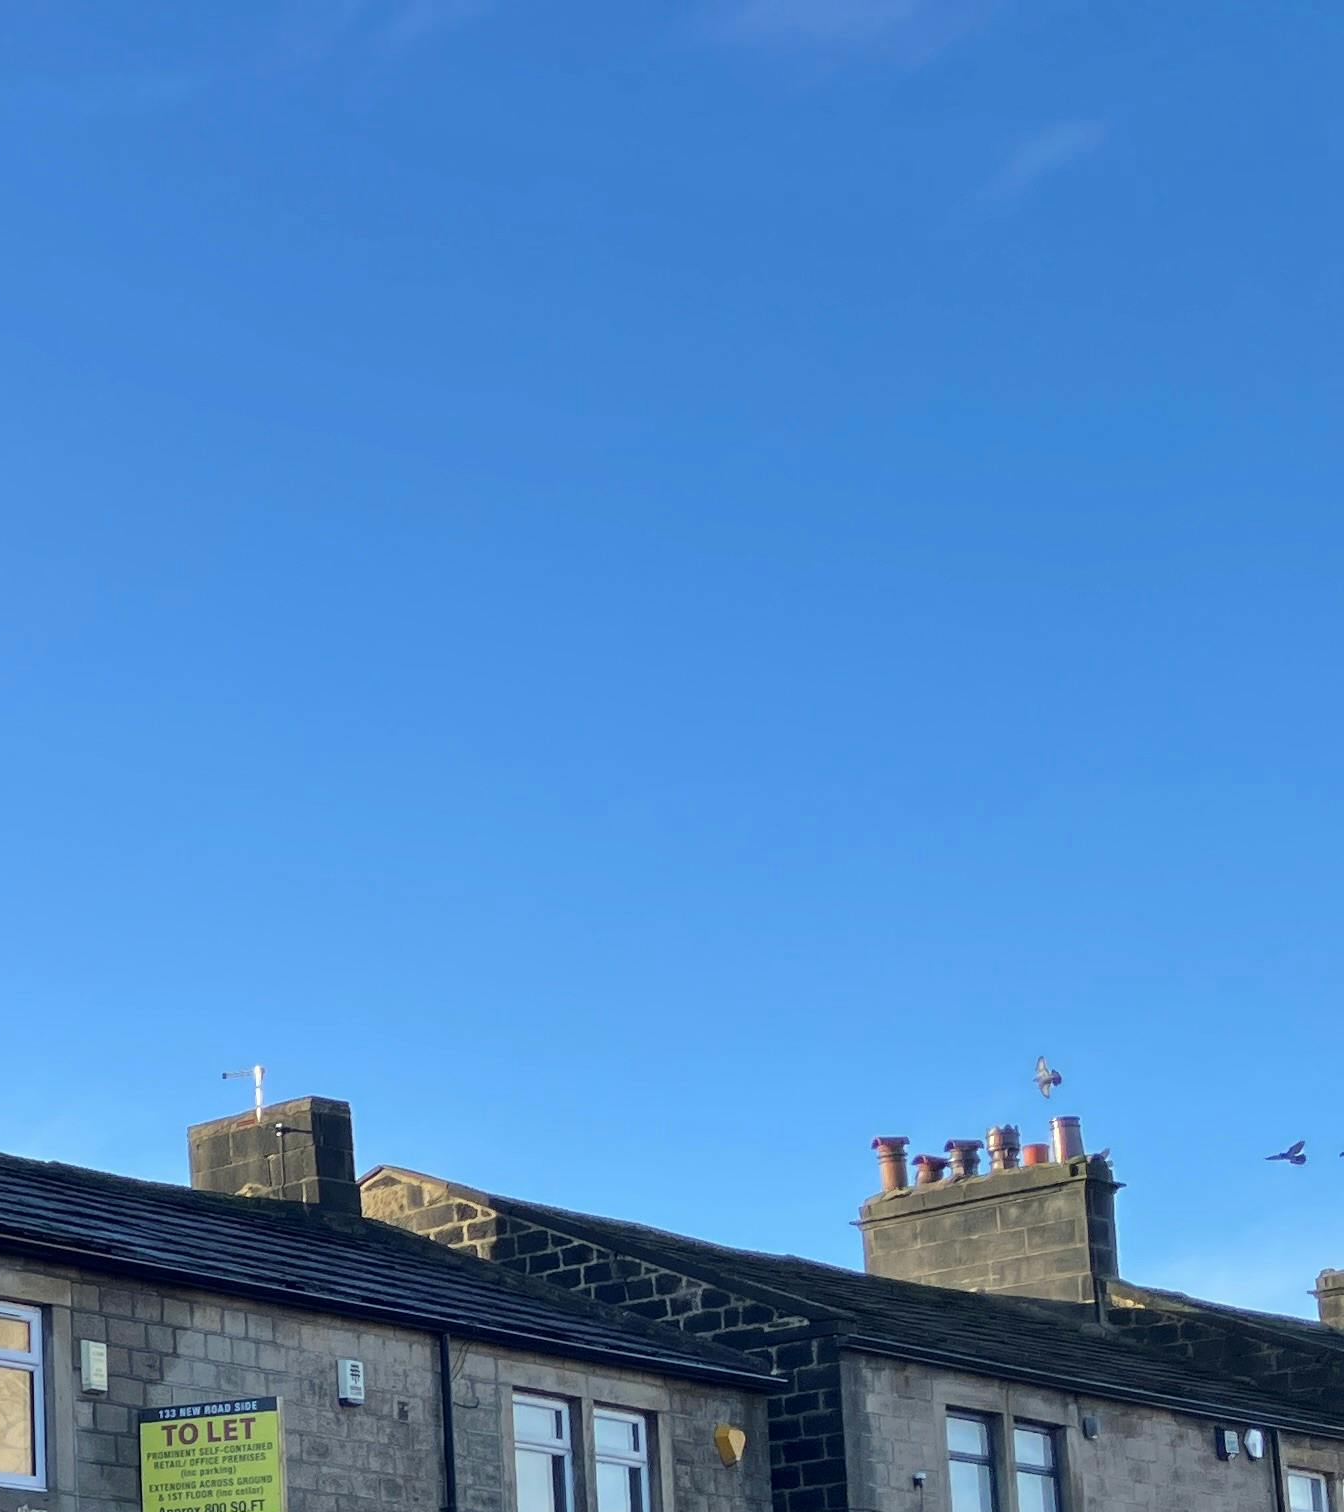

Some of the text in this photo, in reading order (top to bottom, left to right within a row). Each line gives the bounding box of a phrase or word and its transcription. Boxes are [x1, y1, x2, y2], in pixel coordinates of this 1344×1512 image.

[158, 1400, 258, 1419] 133 NEW ROAD SIDE
[161, 1417, 257, 1446] TO LET
[146, 1442, 273, 1461] PROMINENT SELF-CONTAINED
[190, 1456, 219, 1467] OFFICE
[222, 1452, 267, 1464] PREMISES
[200, 1465, 237, 1477] parking)
[149, 1475, 273, 1493] EXTENDING ACROSS GROUND
[167, 1490, 182, 1501] 1ST
[186, 1489, 213, 1500] FLOOR
